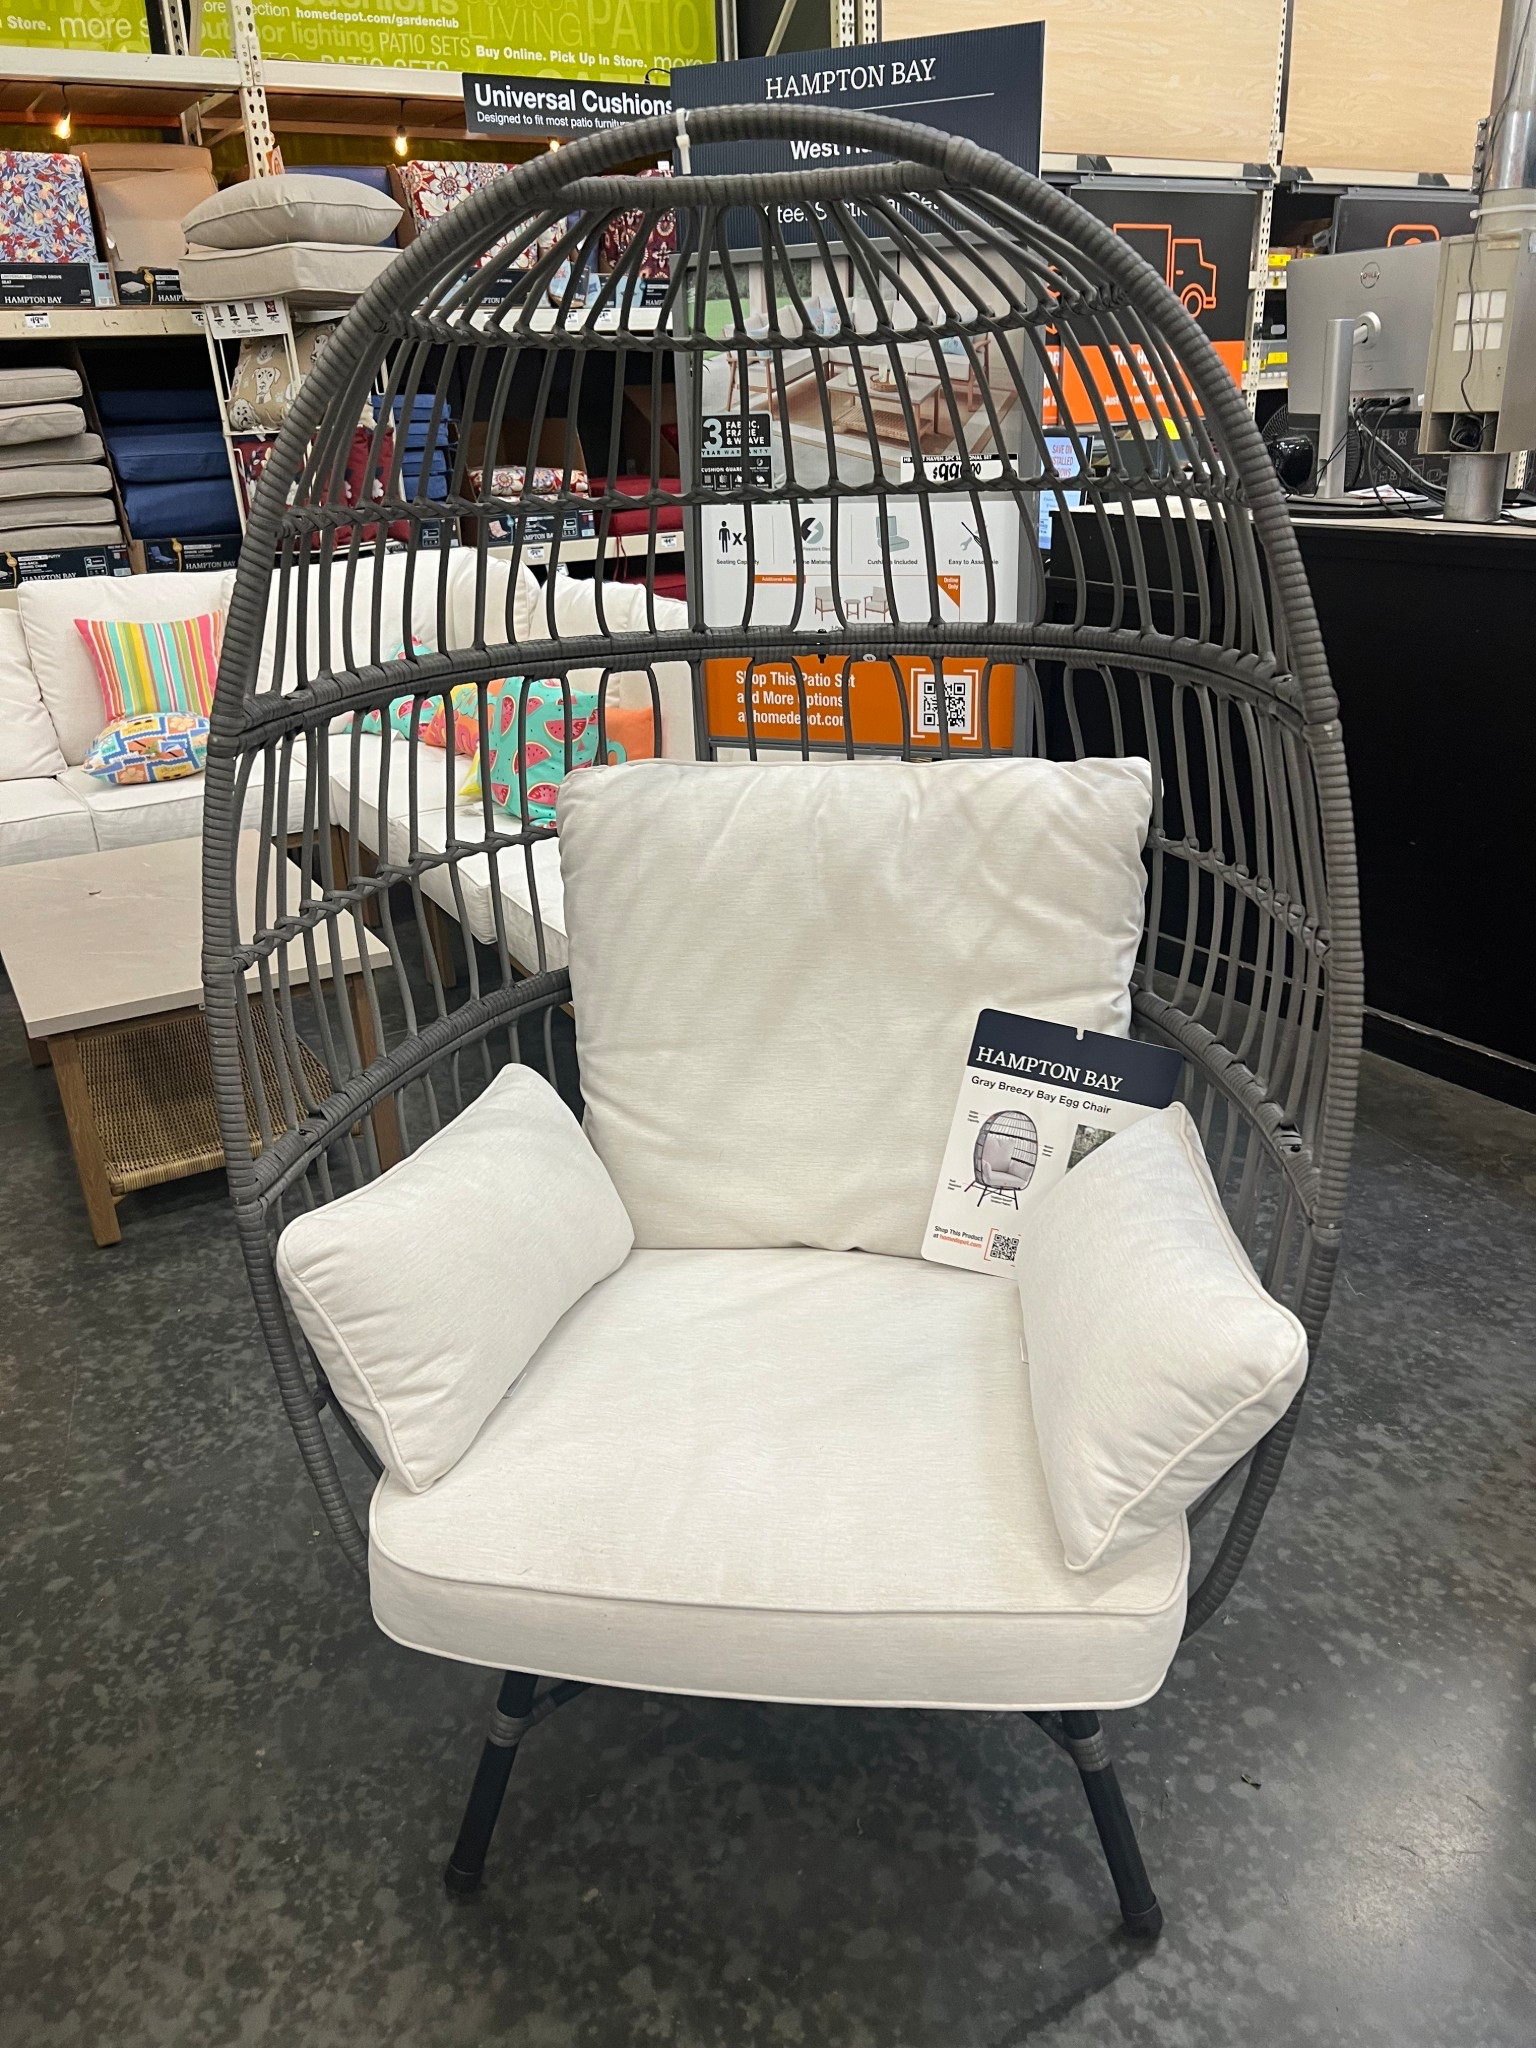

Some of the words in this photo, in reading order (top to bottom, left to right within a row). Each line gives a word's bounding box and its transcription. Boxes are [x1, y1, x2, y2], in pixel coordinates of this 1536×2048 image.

[7, 15, 51, 31] Store.
[295, 7, 459, 29] homedepot.com/gardenclub
[467, 5, 583, 46] LIVING
[60, 16, 132, 39] more
[292, 23, 374, 53] lighting
[379, 32, 425, 55] PATIO
[431, 36, 470, 58] SETS
[476, 44, 500, 60] Buy
[503, 47, 546, 62] Online.
[550, 49, 576, 64] Pick
[579, 52, 596, 67] Up
[599, 54, 610, 66] In
[613, 55, 648, 69] Store.
[765, 64, 886, 100] HAMPTON
[890, 57, 937, 86] BAY
[474, 82, 576, 112] Universal
[581, 88, 672, 116] Cushions
[476, 111, 519, 126] Designed
[522, 114, 533, 125] to
[534, 114, 545, 126] fit
[547, 117, 569, 128] most
[570, 118, 593, 129] patio
[4, 296, 46, 304] HAMPTON
[47, 296, 62, 304] BAY
[702, 418, 723, 449] 3
[726, 429, 757, 437] FRAE
[734, 436, 765, 445] WAVE
[1052, 444, 1064, 454] SAVE
[1065, 444, 1073, 454] ON
[185, 561, 222, 570] HAMPTON
[223, 560, 236, 568] BAY
[22, 574, 61, 582] HAMPTON
[735, 670, 767, 688] Sop
[769, 671, 797, 686] This
[834, 673, 856, 688] St
[737, 690, 760, 704] ad
[763, 691, 794, 706] More
[798, 693, 843, 709] ptions
[975, 1046, 1082, 1084] HAMPTON
[1082, 1069, 1124, 1093] BAY
[971, 1075, 996, 1090] Gray
[997, 1081, 1035, 1099] Breezy
[1036, 1089, 1057, 1104] Bay
[1059, 1095, 1080, 1109] Egg
[1082, 1100, 1112, 1115] Chair
[934, 1225, 949, 1235] Shop
[949, 1228, 961, 1237] This
[962, 1231, 984, 1242] Product
[939, 1233, 983, 1249] homedepot.com
